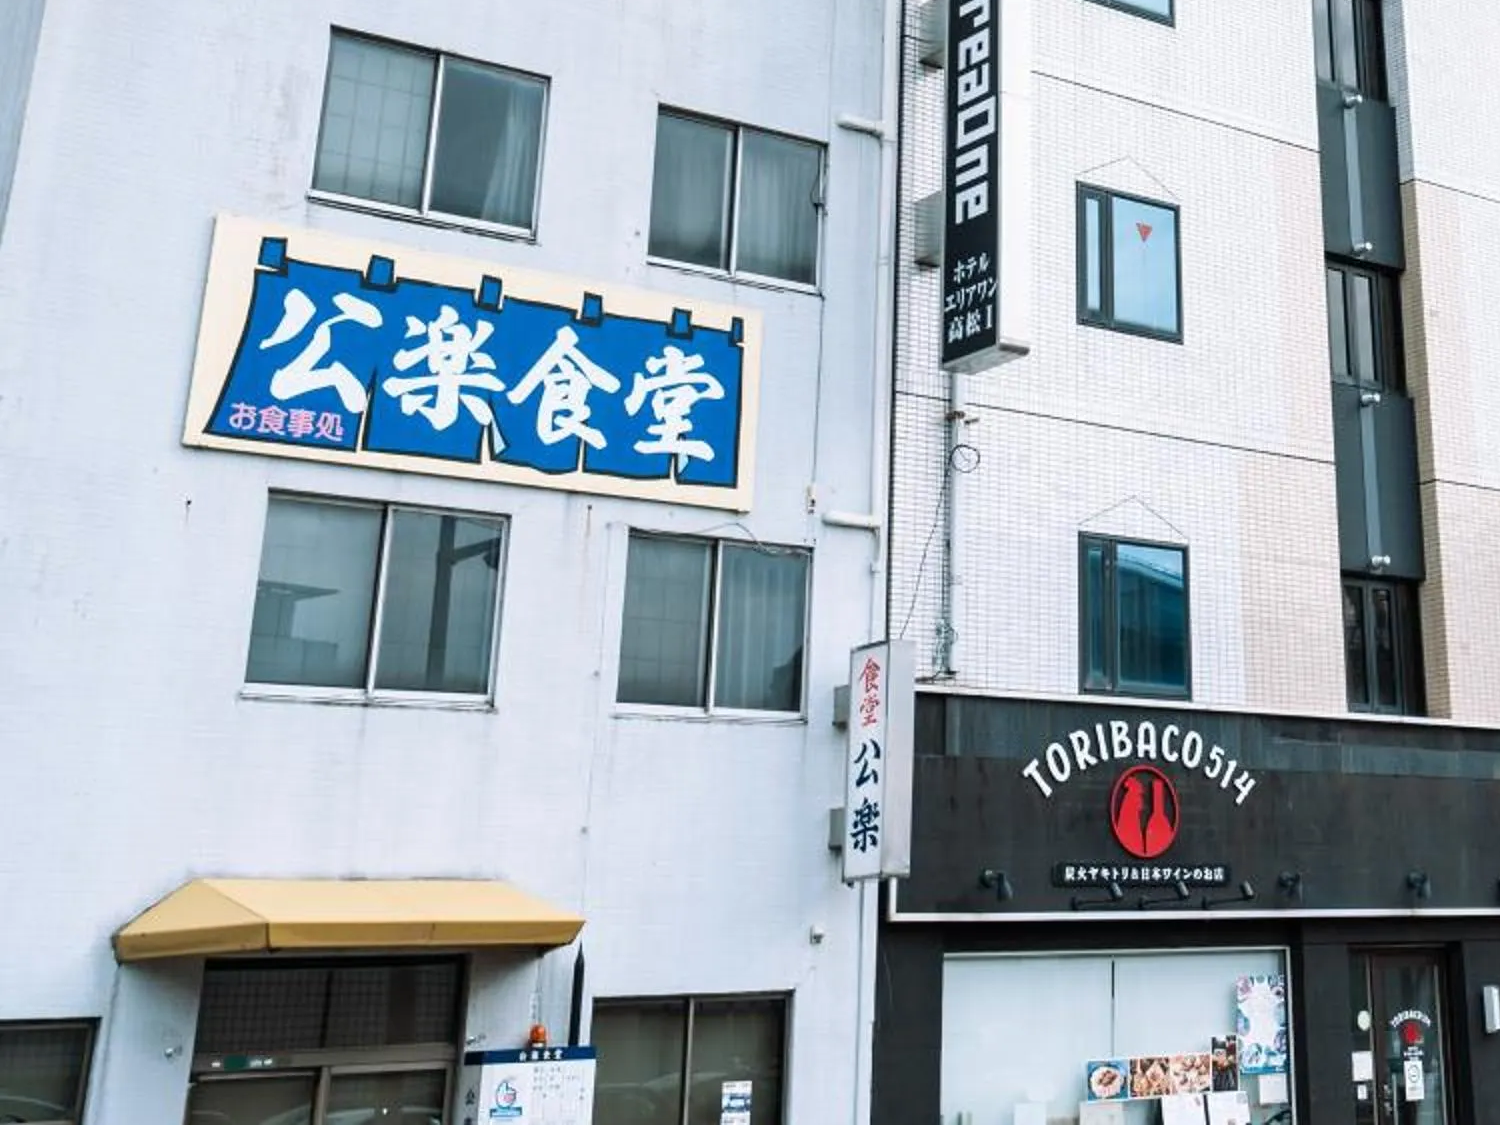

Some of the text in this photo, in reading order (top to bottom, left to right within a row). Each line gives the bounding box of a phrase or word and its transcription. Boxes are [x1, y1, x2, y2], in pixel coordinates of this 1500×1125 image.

[944, 277, 998, 311] エリアワン
[953, 252, 990, 283] ホテル
[259, 288, 726, 461] 公楽食堂
[229, 401, 345, 442] お食事処
[859, 657, 881, 727] 食堂
[850, 738, 882, 853] 公楽
